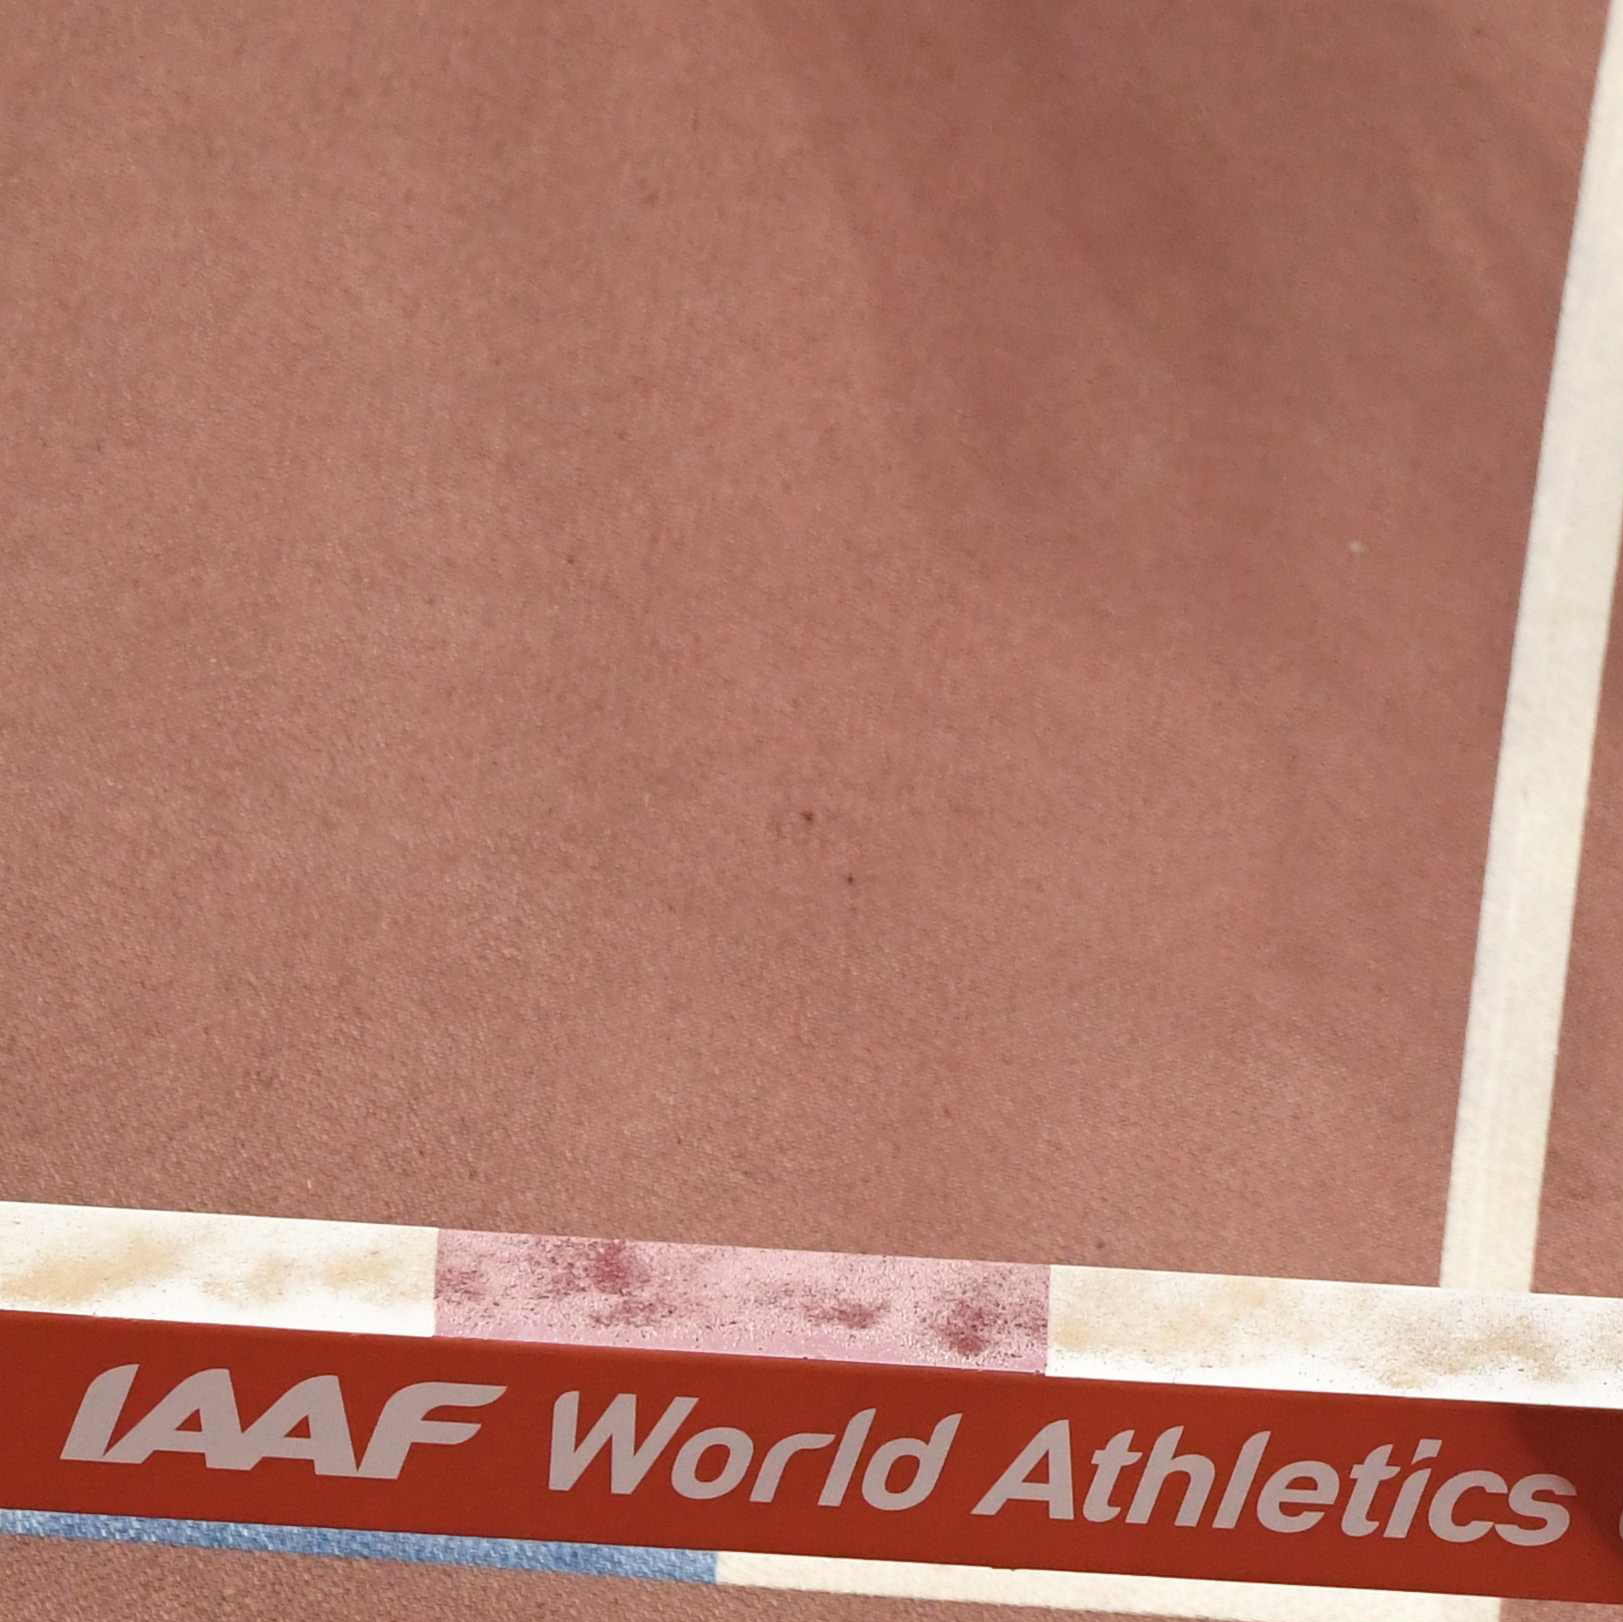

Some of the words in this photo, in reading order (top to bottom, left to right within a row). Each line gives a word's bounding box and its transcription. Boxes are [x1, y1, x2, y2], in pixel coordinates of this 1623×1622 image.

[60, 1363, 507, 1480] IAAF
[548, 1390, 963, 1512] World
[970, 1419, 1578, 1547] Athletics
